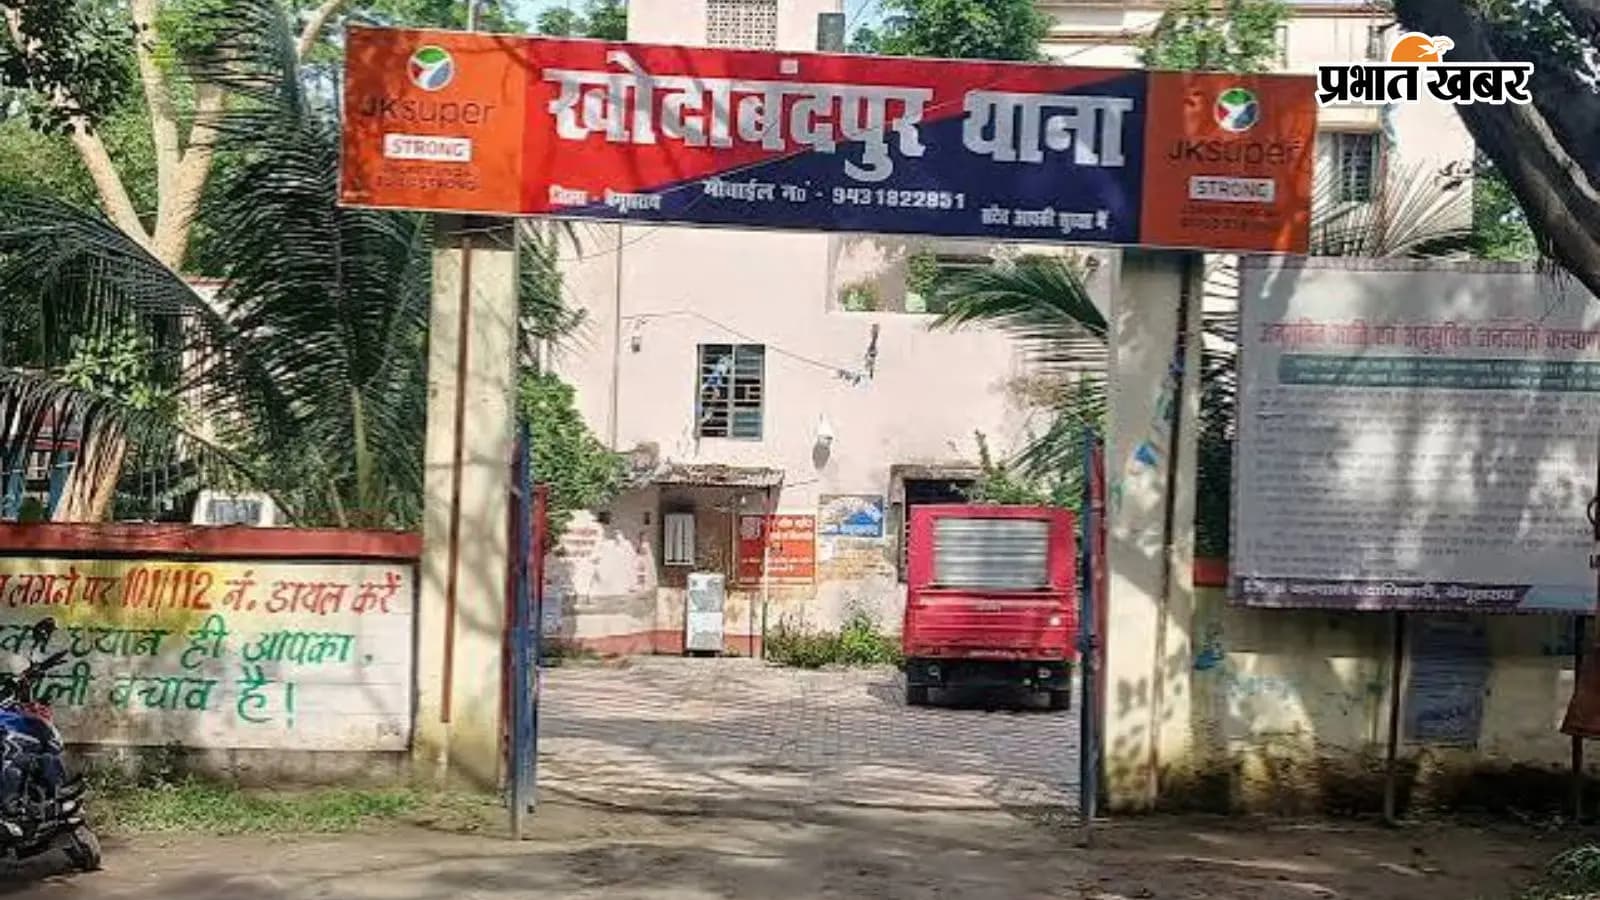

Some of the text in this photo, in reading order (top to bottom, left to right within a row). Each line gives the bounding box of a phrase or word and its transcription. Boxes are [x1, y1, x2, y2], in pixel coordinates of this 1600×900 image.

[543, 50, 1132, 182] खोदाबंदपुर थाना
[391, 138, 465, 157] STRONG
[1196, 180, 1269, 198] STRONG
[265, 580, 350, 616] डायल
[352, 572, 402, 616] करें
[67, 625, 173, 657] ध्यान
[180, 613, 228, 669] ही
[242, 629, 356, 665] आपका
